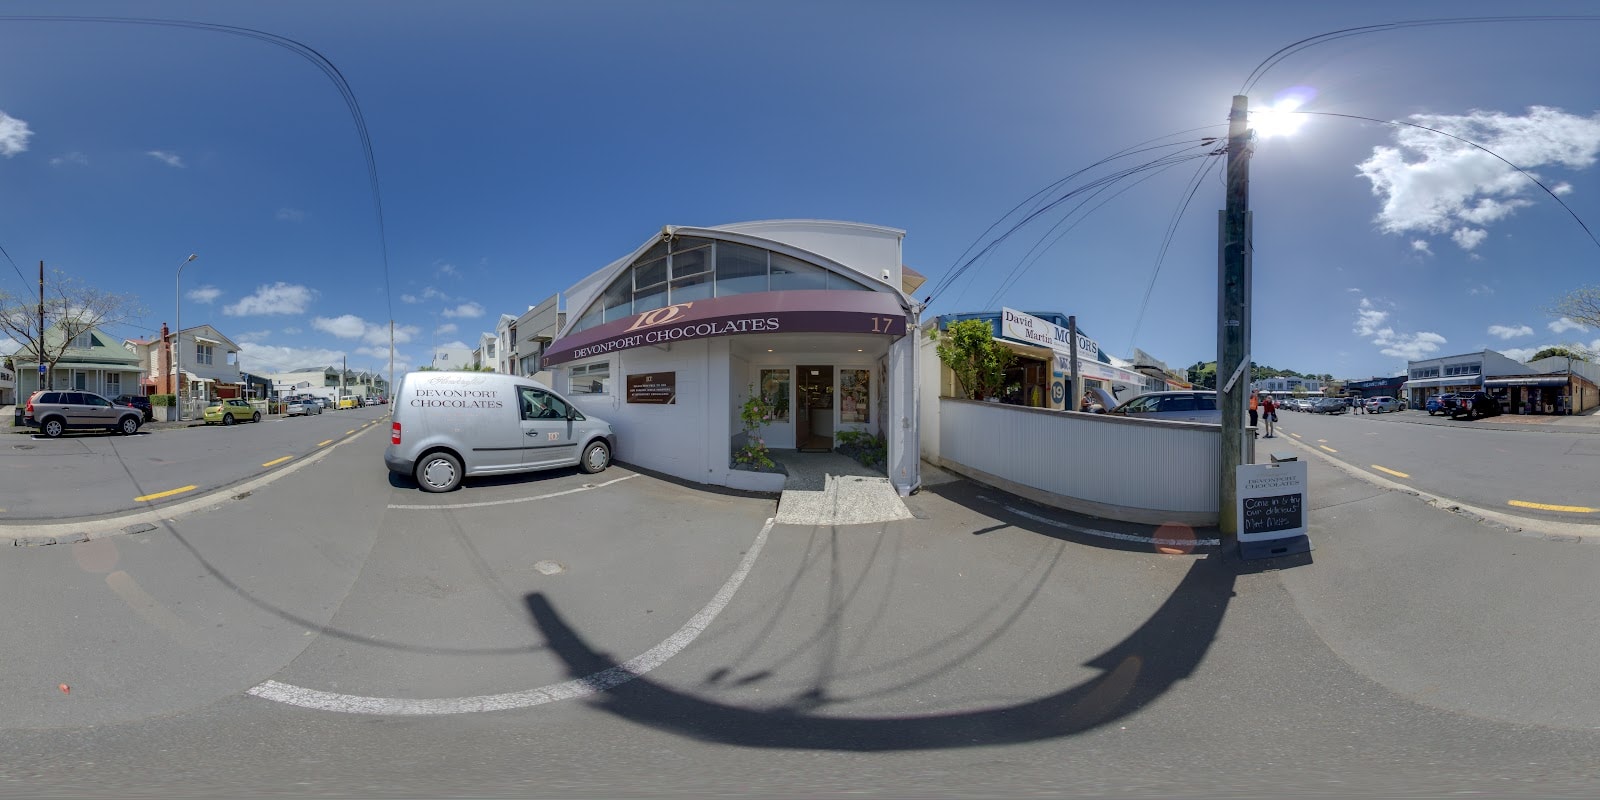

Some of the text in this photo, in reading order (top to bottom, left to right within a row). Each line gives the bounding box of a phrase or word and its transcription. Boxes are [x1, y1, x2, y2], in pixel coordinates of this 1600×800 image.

[871, 317, 893, 333] 17
[1005, 311, 1033, 327] David
[574, 317, 780, 358] DEVONPORT CHOCOLATES
[1025, 329, 1052, 344] Martin
[1054, 326, 1097, 353] MOORS
[416, 389, 498, 398] DEVONPORT
[1052, 385, 1063, 399] 19
[410, 399, 503, 409] CHOCOLATES
[1245, 481, 1300, 489] CHOCOLATES
[1245, 498, 1268, 509] Come
[1266, 505, 1297, 515] delicious
[1245, 518, 1263, 529] Mint
